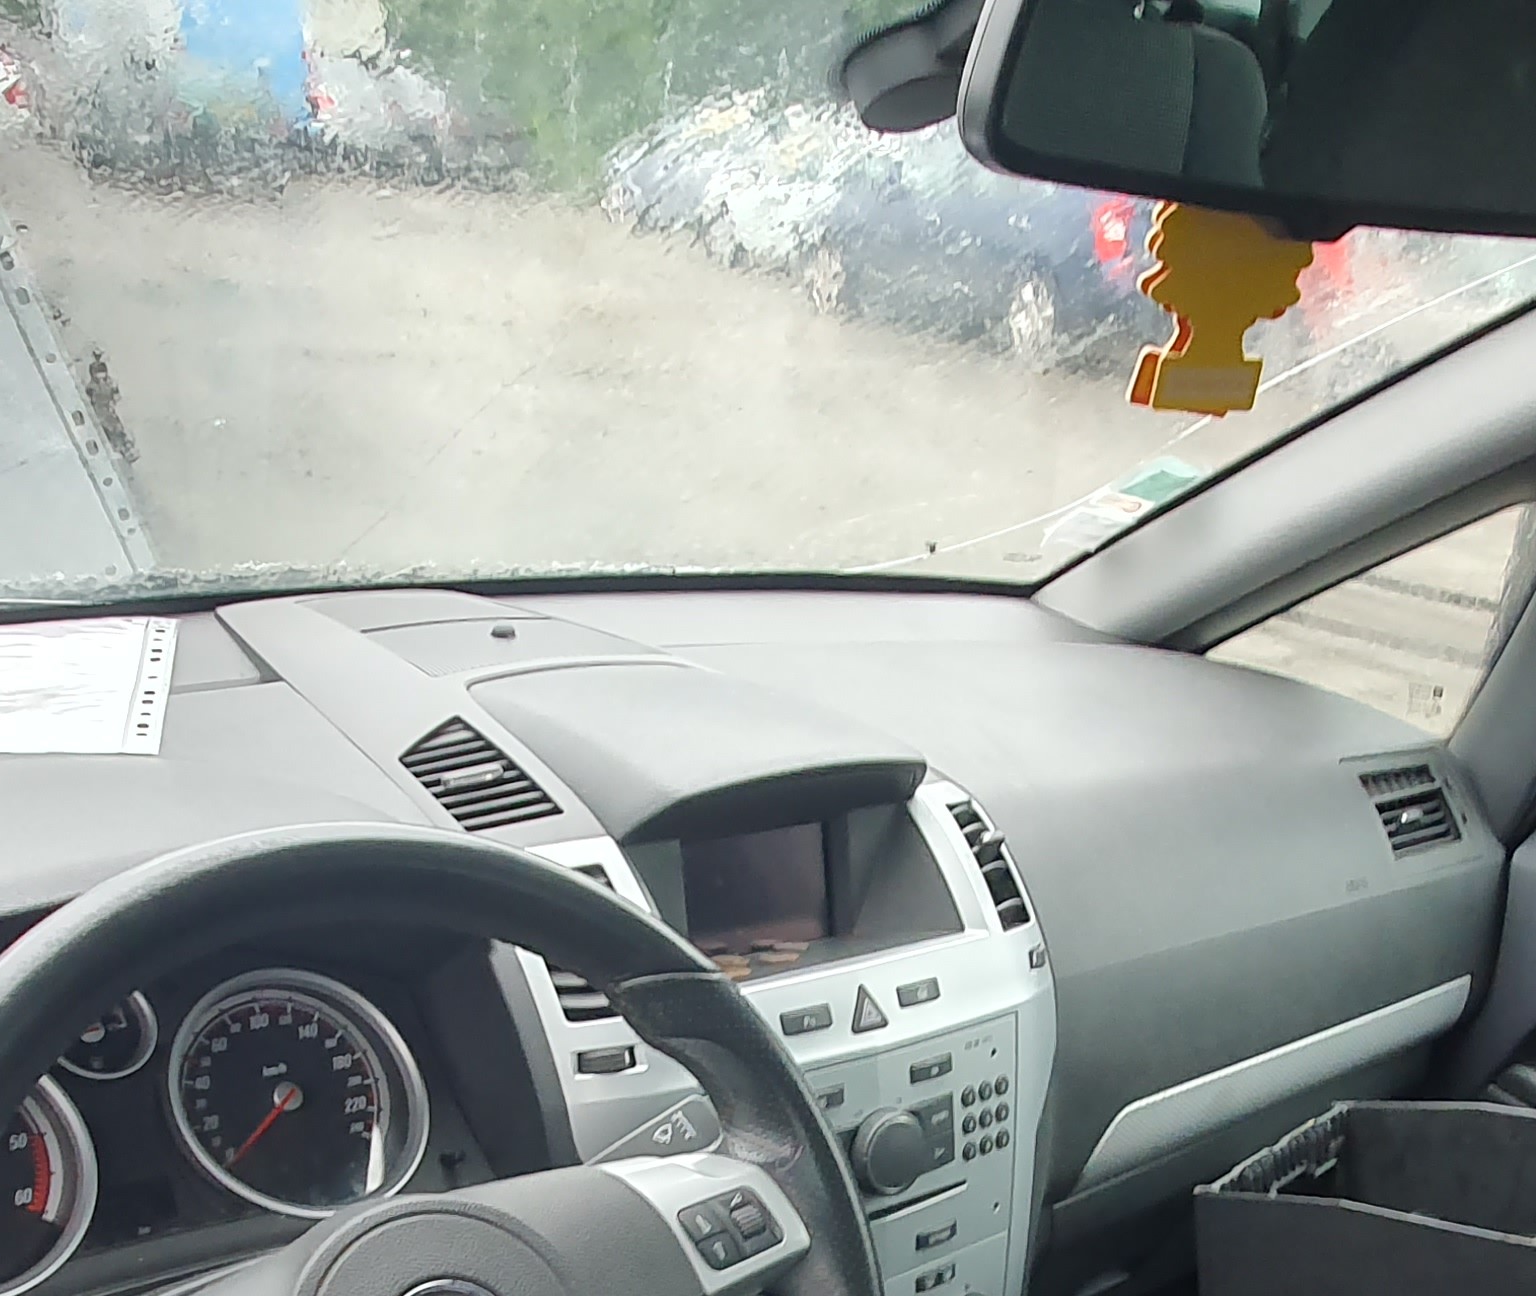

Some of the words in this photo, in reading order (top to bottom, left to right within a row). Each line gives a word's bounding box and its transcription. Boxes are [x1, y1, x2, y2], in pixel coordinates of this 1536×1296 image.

[298, 1022, 318, 1040] 140
[344, 1095, 367, 1115] 220
[202, 1114, 219, 1131] 20
[9, 1132, 28, 1151] 50
[14, 1187, 33, 1206] 60
